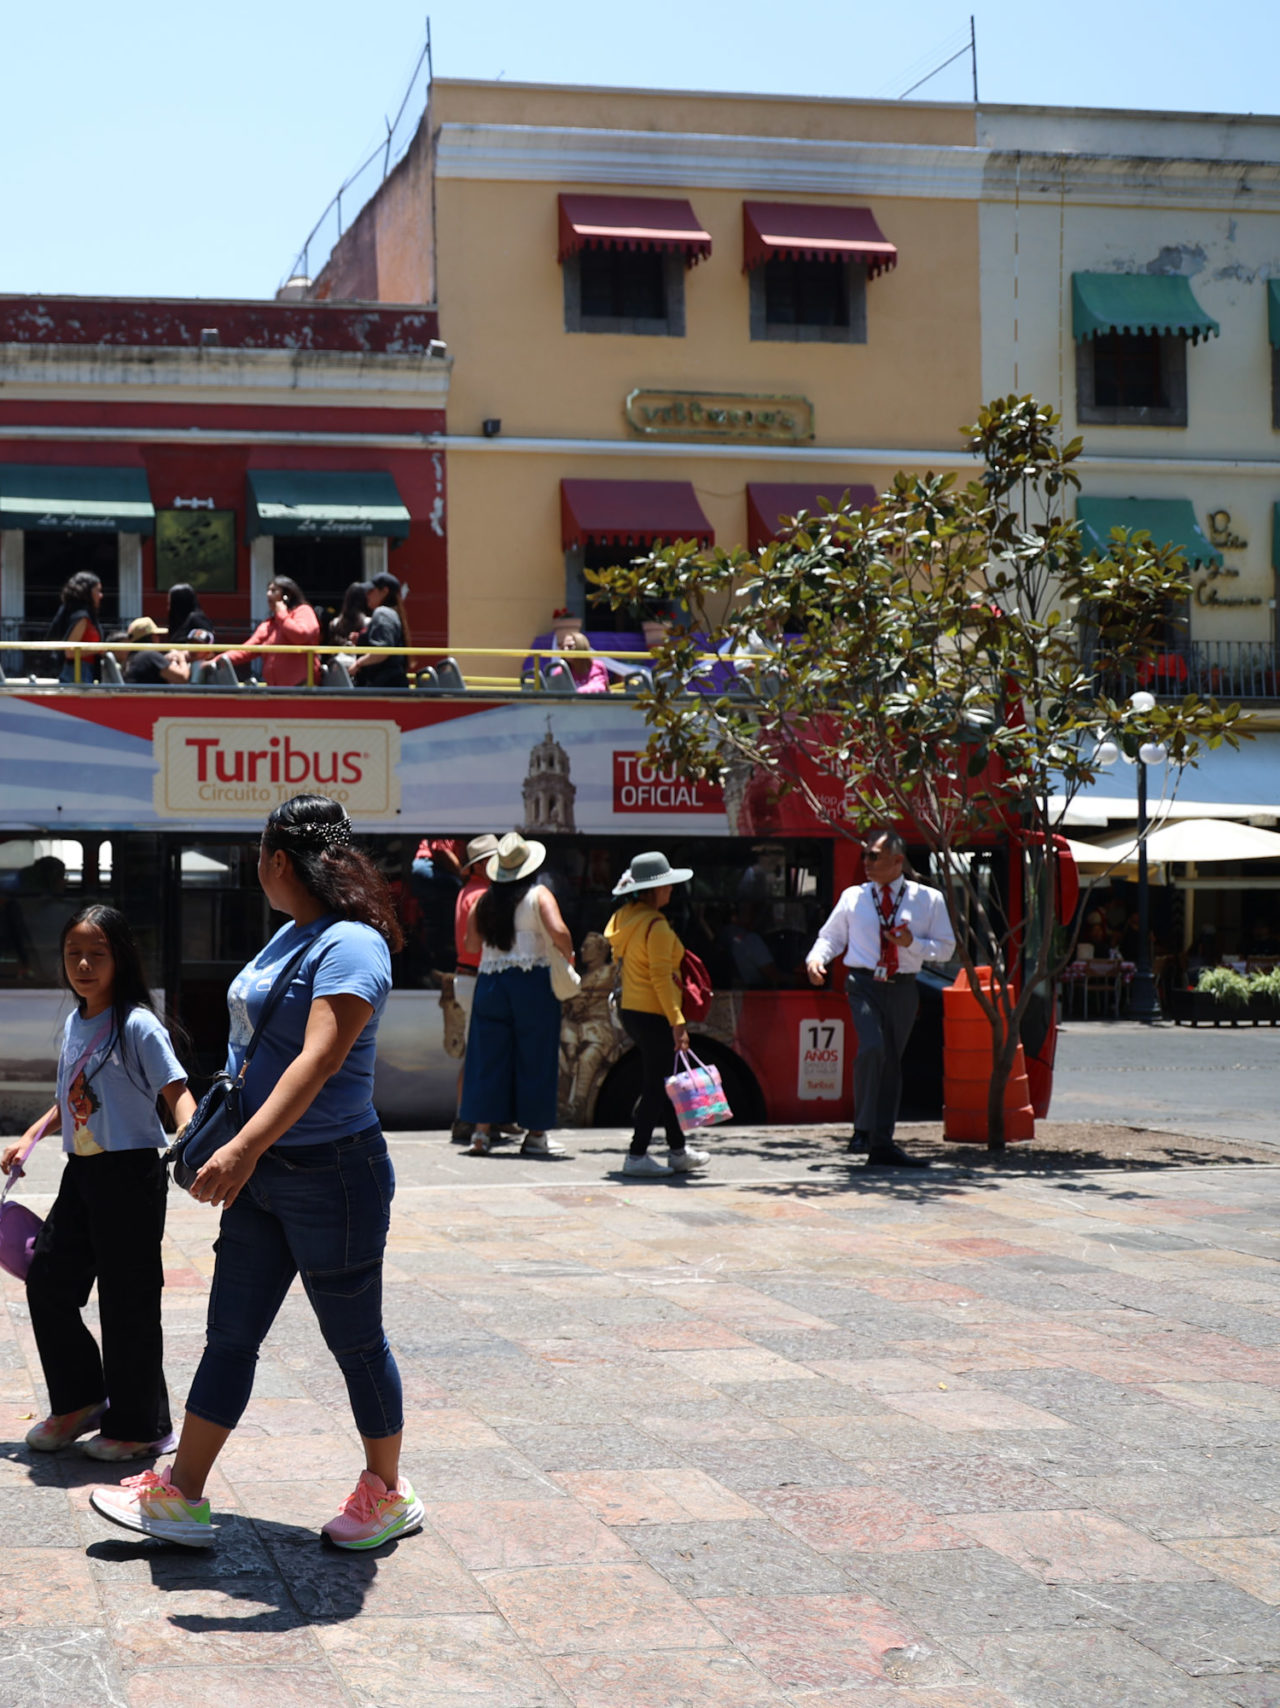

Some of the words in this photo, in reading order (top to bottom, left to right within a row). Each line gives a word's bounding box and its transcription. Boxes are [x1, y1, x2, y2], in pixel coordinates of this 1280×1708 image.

[617, 757, 686, 783] TOU
[198, 784, 270, 801] Circuito
[621, 785, 704, 806] OFICIAL
[808, 1027, 835, 1048] 17
[804, 1048, 838, 1062] AÑOS
